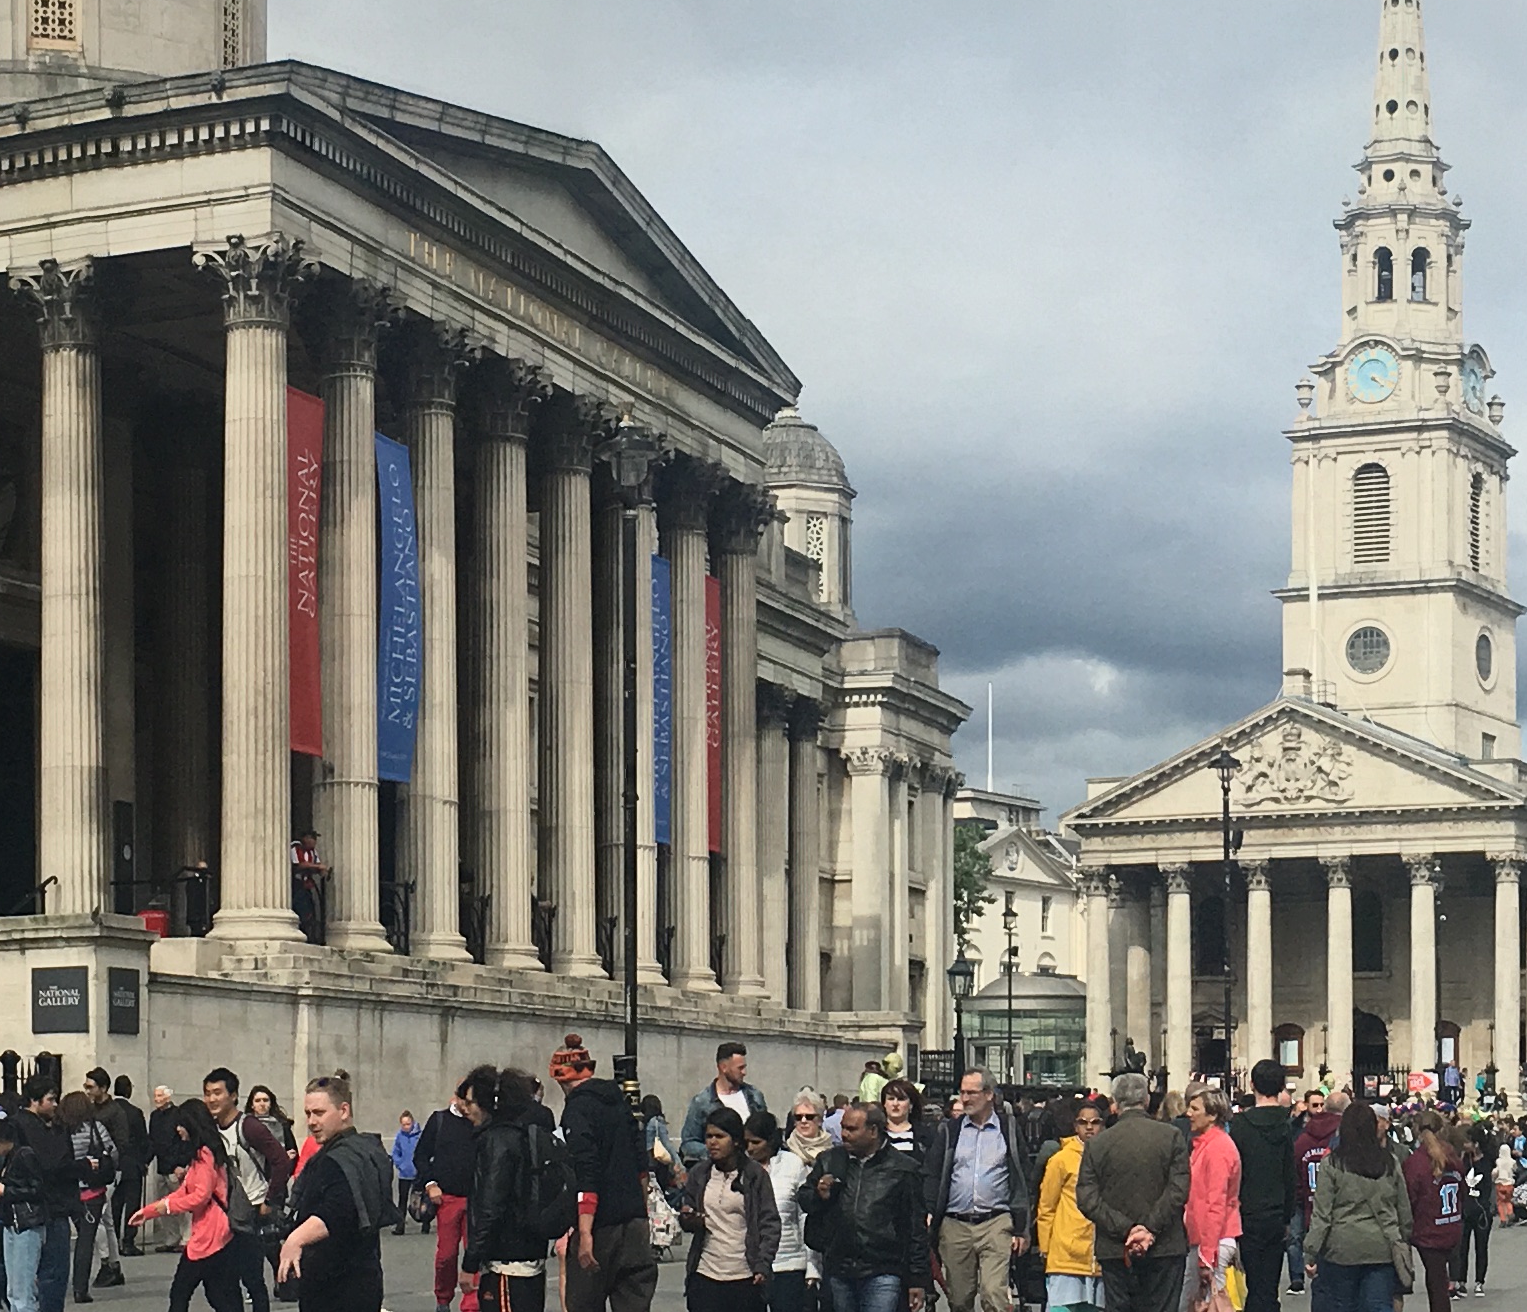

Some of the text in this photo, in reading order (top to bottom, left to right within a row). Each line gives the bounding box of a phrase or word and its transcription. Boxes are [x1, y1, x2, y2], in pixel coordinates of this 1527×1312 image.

[405, 230, 455, 281] THE
[297, 447, 310, 613] NATIONAL
[387, 463, 406, 724] MICHELANGELO
[403, 508, 417, 729] & SEBASTIANO
[38, 997, 79, 1006] GALLERY
[39, 989, 80, 997] NATIONAL
[1439, 1182, 1459, 1215] 17
